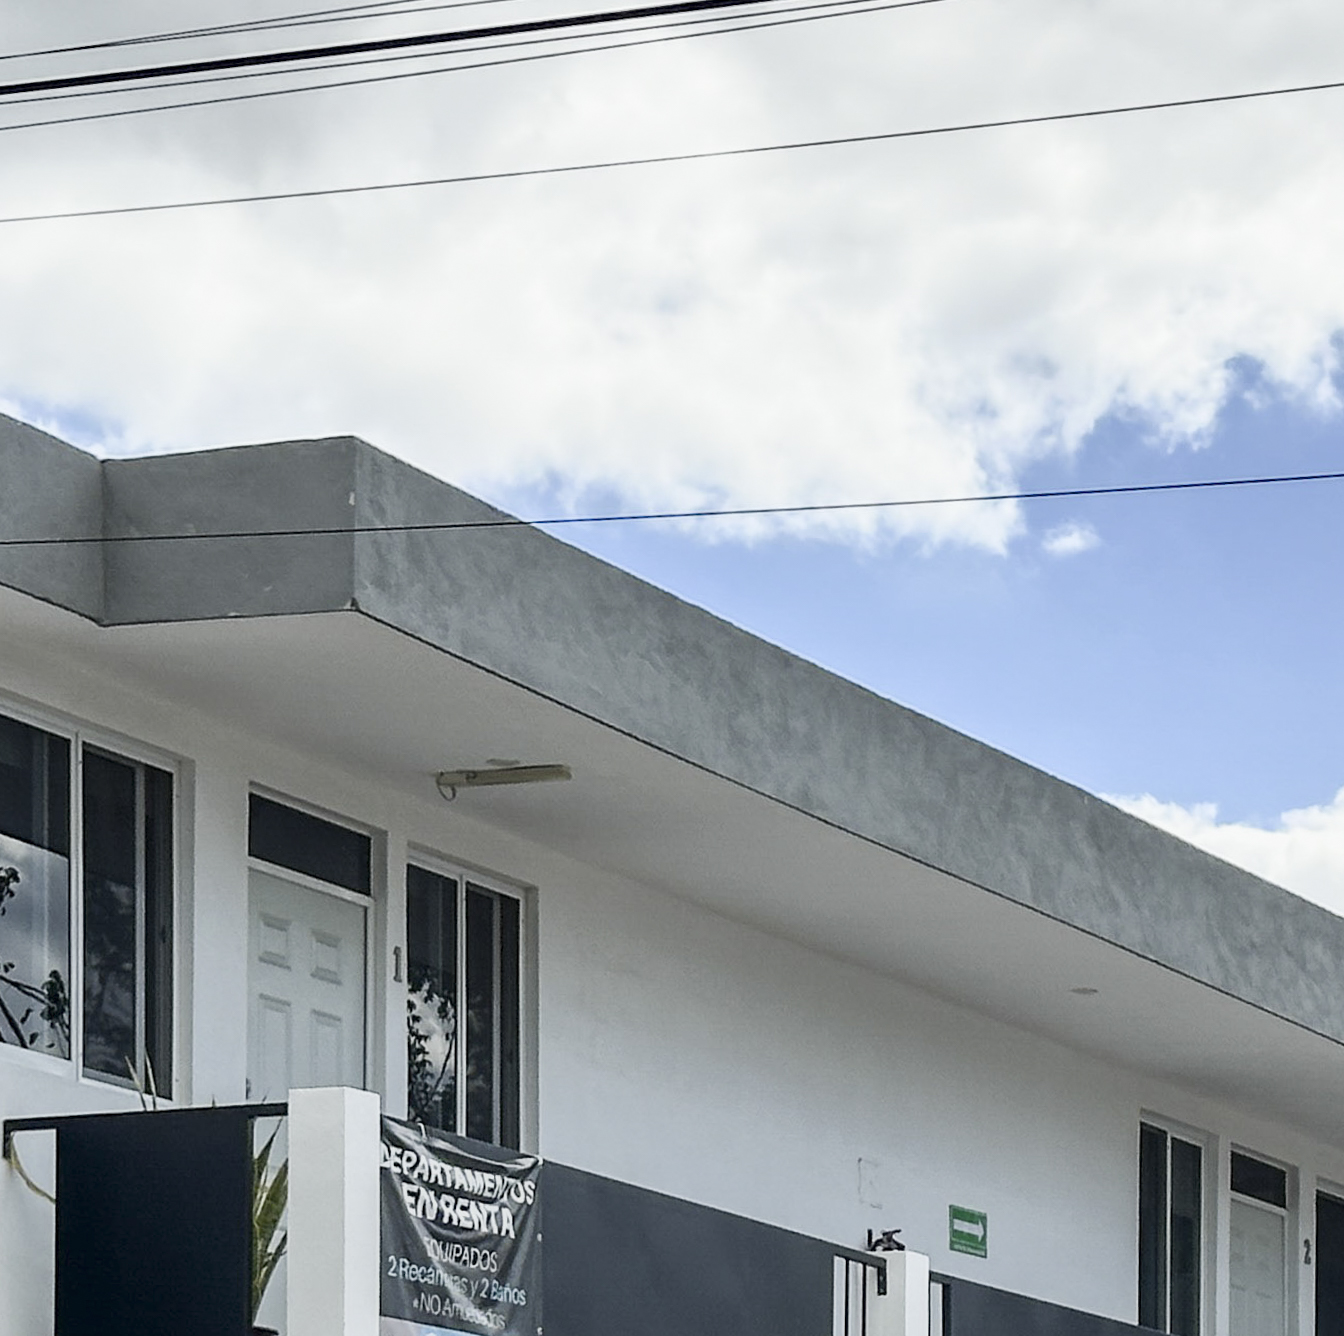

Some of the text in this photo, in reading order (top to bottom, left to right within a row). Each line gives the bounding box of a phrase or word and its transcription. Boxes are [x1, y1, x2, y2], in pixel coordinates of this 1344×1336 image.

[380, 1142, 536, 1206] DEPARTAMENTOS
[401, 1182, 516, 1239] EN RENTA
[387, 1255, 398, 1277] 2
[470, 1279, 479, 1299] y
[480, 1278, 489, 1298] 2
[491, 1280, 527, 1306] Baños
[423, 1236, 499, 1273] EQUIPADOS
